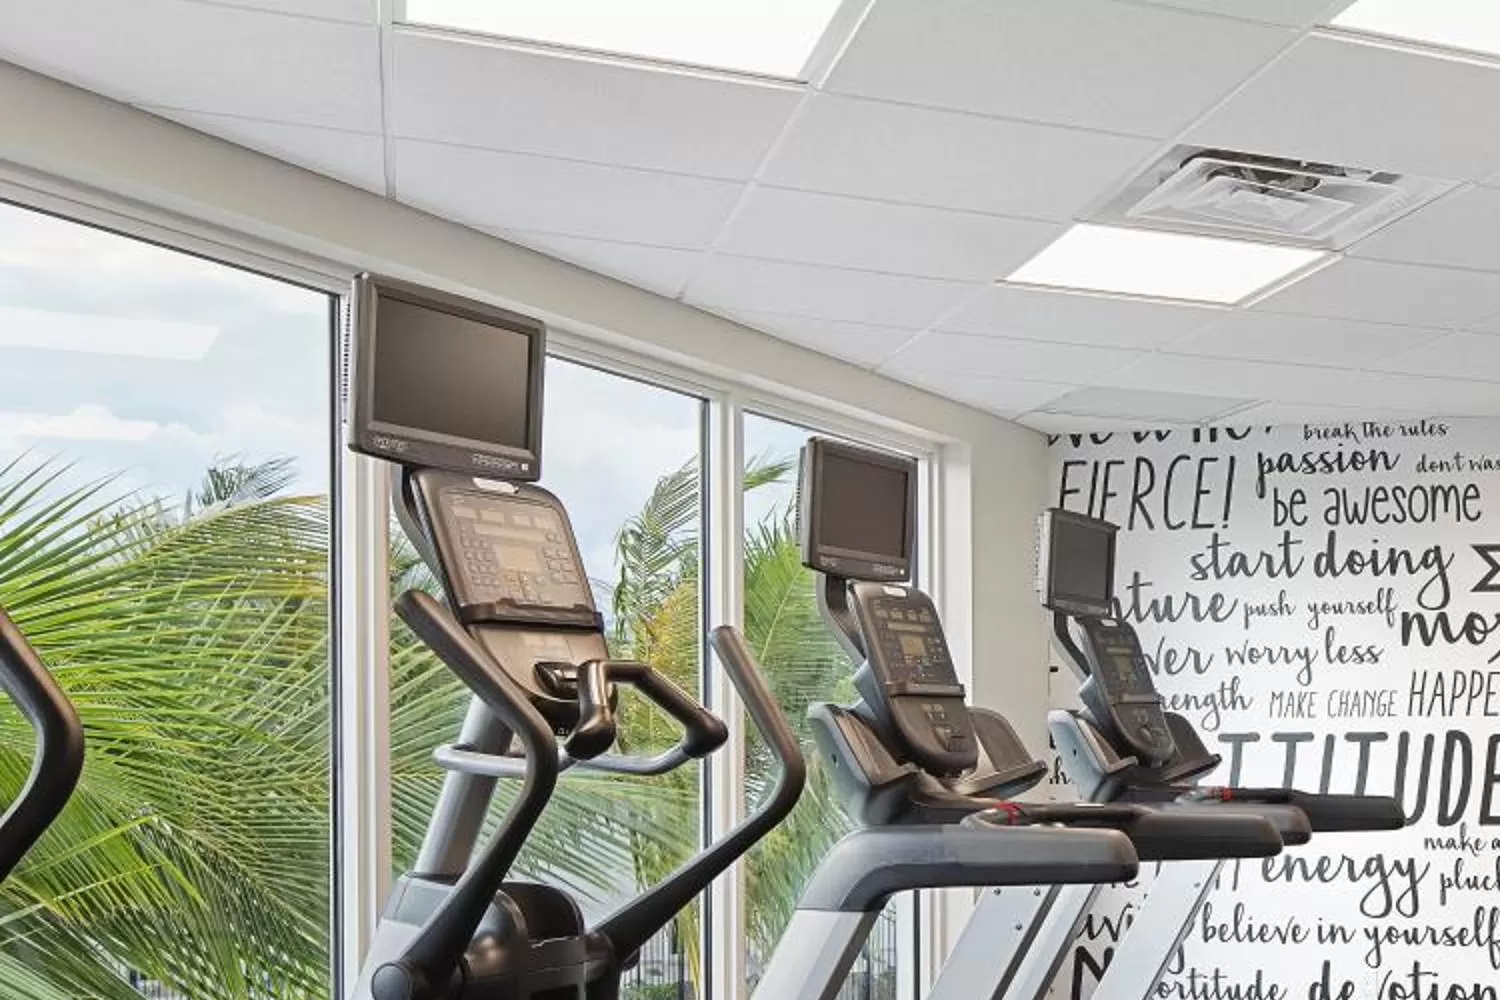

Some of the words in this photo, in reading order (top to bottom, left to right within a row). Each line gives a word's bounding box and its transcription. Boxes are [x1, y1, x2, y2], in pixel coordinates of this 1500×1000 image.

[1303, 422, 1362, 446] break
[1362, 420, 1398, 440] the
[1399, 418, 1450, 438] rules
[1059, 453, 1237, 532] FIERCE!
[1255, 443, 1402, 500] passion
[1272, 486, 1308, 528] be
[1322, 482, 1483, 527] awesome
[1189, 531, 1305, 582] start
[1312, 529, 1455, 612] doing
[1242, 588, 1297, 630] push
[1305, 585, 1398, 631] yourself
[1224, 640, 1320, 687] worry
[1324, 626, 1386, 665] less
[1268, 688, 1320, 720] MAKE
[1327, 688, 1398, 719] CHANGE
[1423, 822, 1487, 857] make
[1261, 853, 1431, 919] energy
[1202, 902, 1311, 945] believe
[1316, 921, 1357, 945] in
